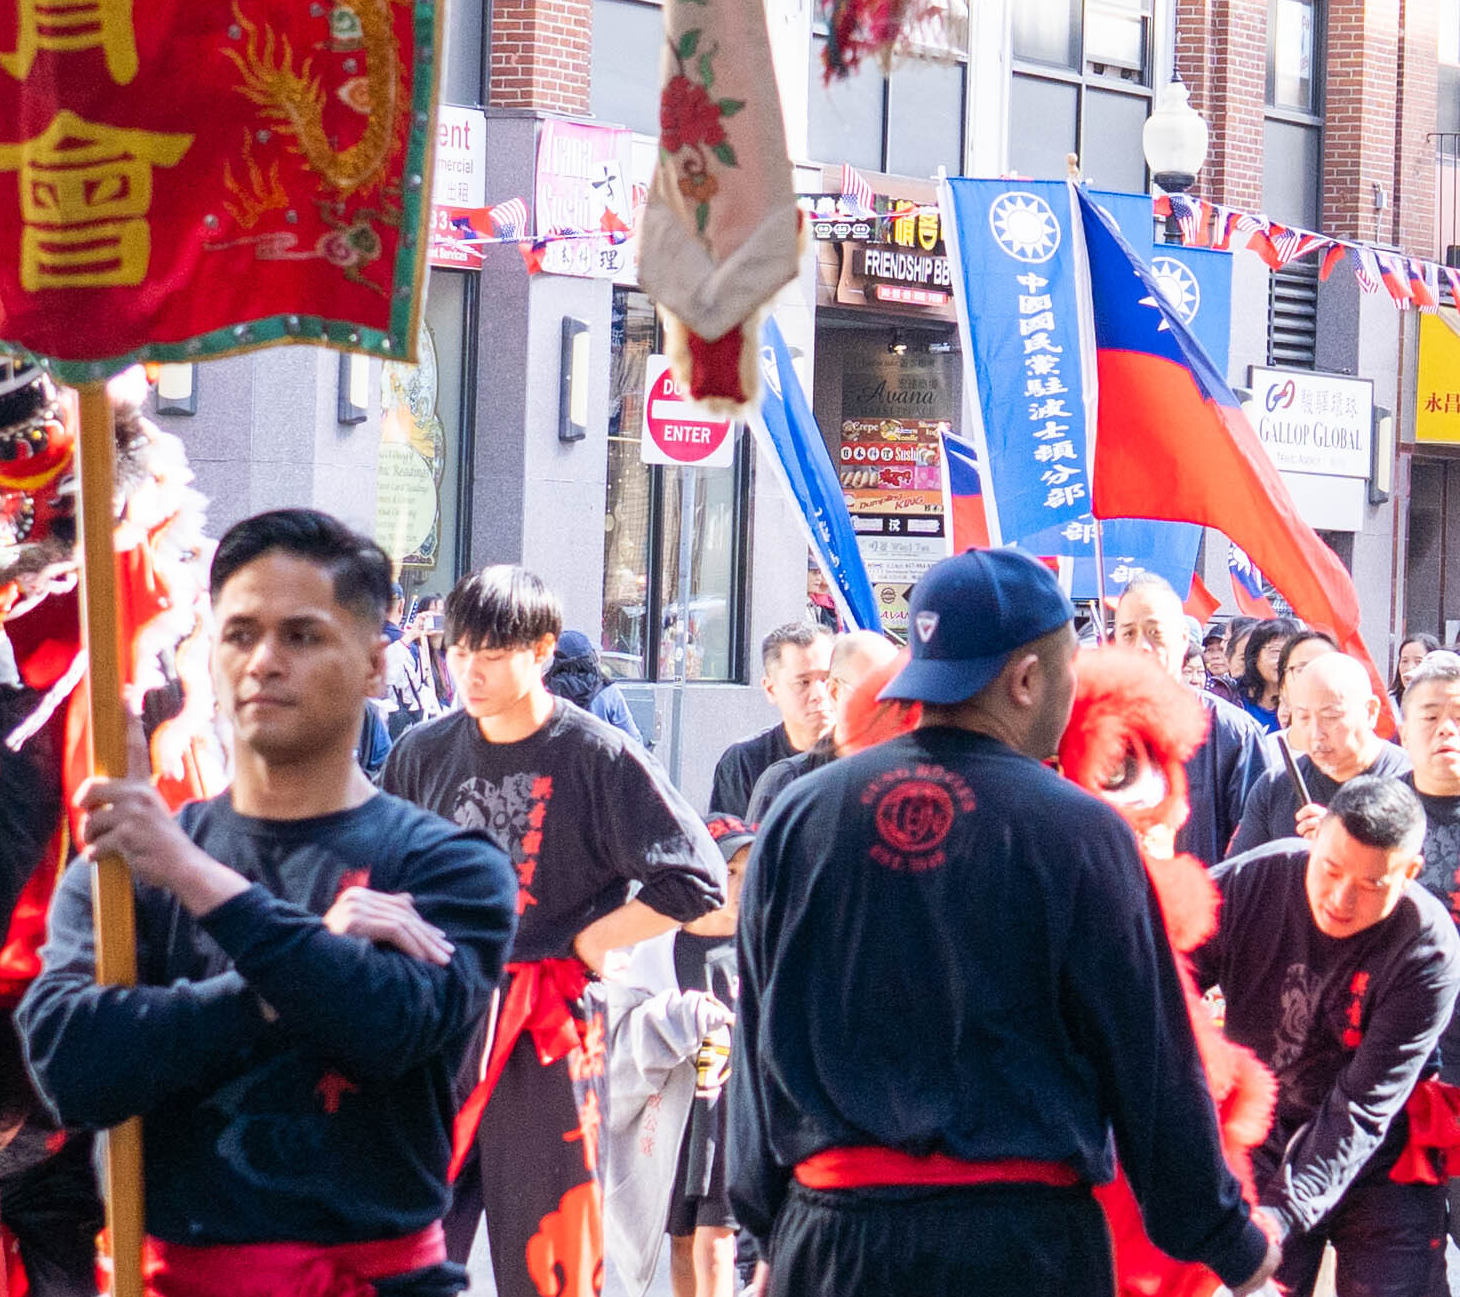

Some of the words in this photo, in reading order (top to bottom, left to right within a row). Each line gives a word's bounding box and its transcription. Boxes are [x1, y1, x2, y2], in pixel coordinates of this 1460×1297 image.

[438, 119, 472, 151] ent
[864, 249, 933, 284] FRIENDSHIP
[933, 258, 953, 286] BB
[663, 425, 711, 444] ENTER
